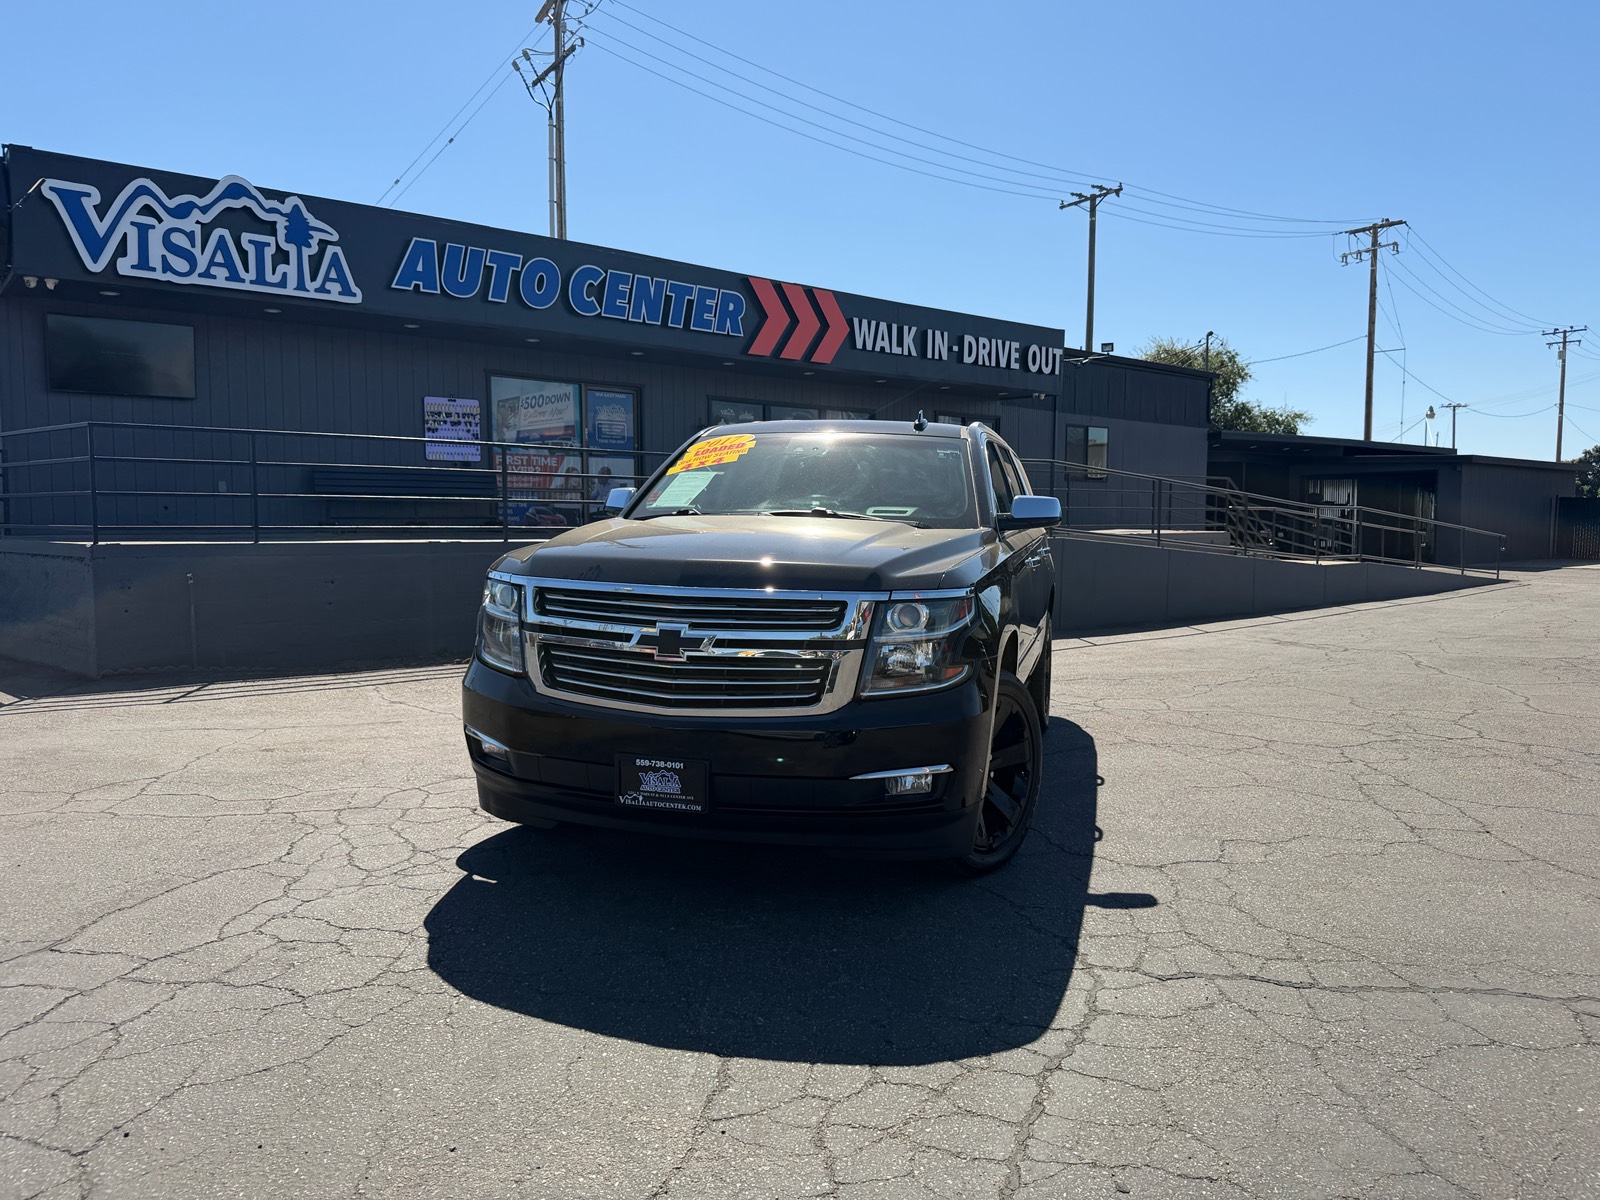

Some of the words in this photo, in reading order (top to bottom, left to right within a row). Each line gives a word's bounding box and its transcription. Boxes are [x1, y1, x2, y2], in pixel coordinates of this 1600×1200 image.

[41, 175, 363, 304] VISALIA
[391, 237, 561, 310] AUTO
[568, 264, 746, 337] CENTER
[852, 317, 917, 357] WALK
[1027, 344, 1063, 375] OUT
[520, 394, 544, 410] $500
[545, 392, 571, 405] DOWN
[693, 442, 746, 457] LOADED
[699, 436, 744, 450] 2017
[496, 455, 528, 465] FRST
[531, 456, 558, 466] TIME
[692, 454, 713, 463] ROW
[713, 448, 747, 458] SEATING
[636, 759, 684, 769] 559-738-0101
[638, 769, 682, 788] VISALIA
